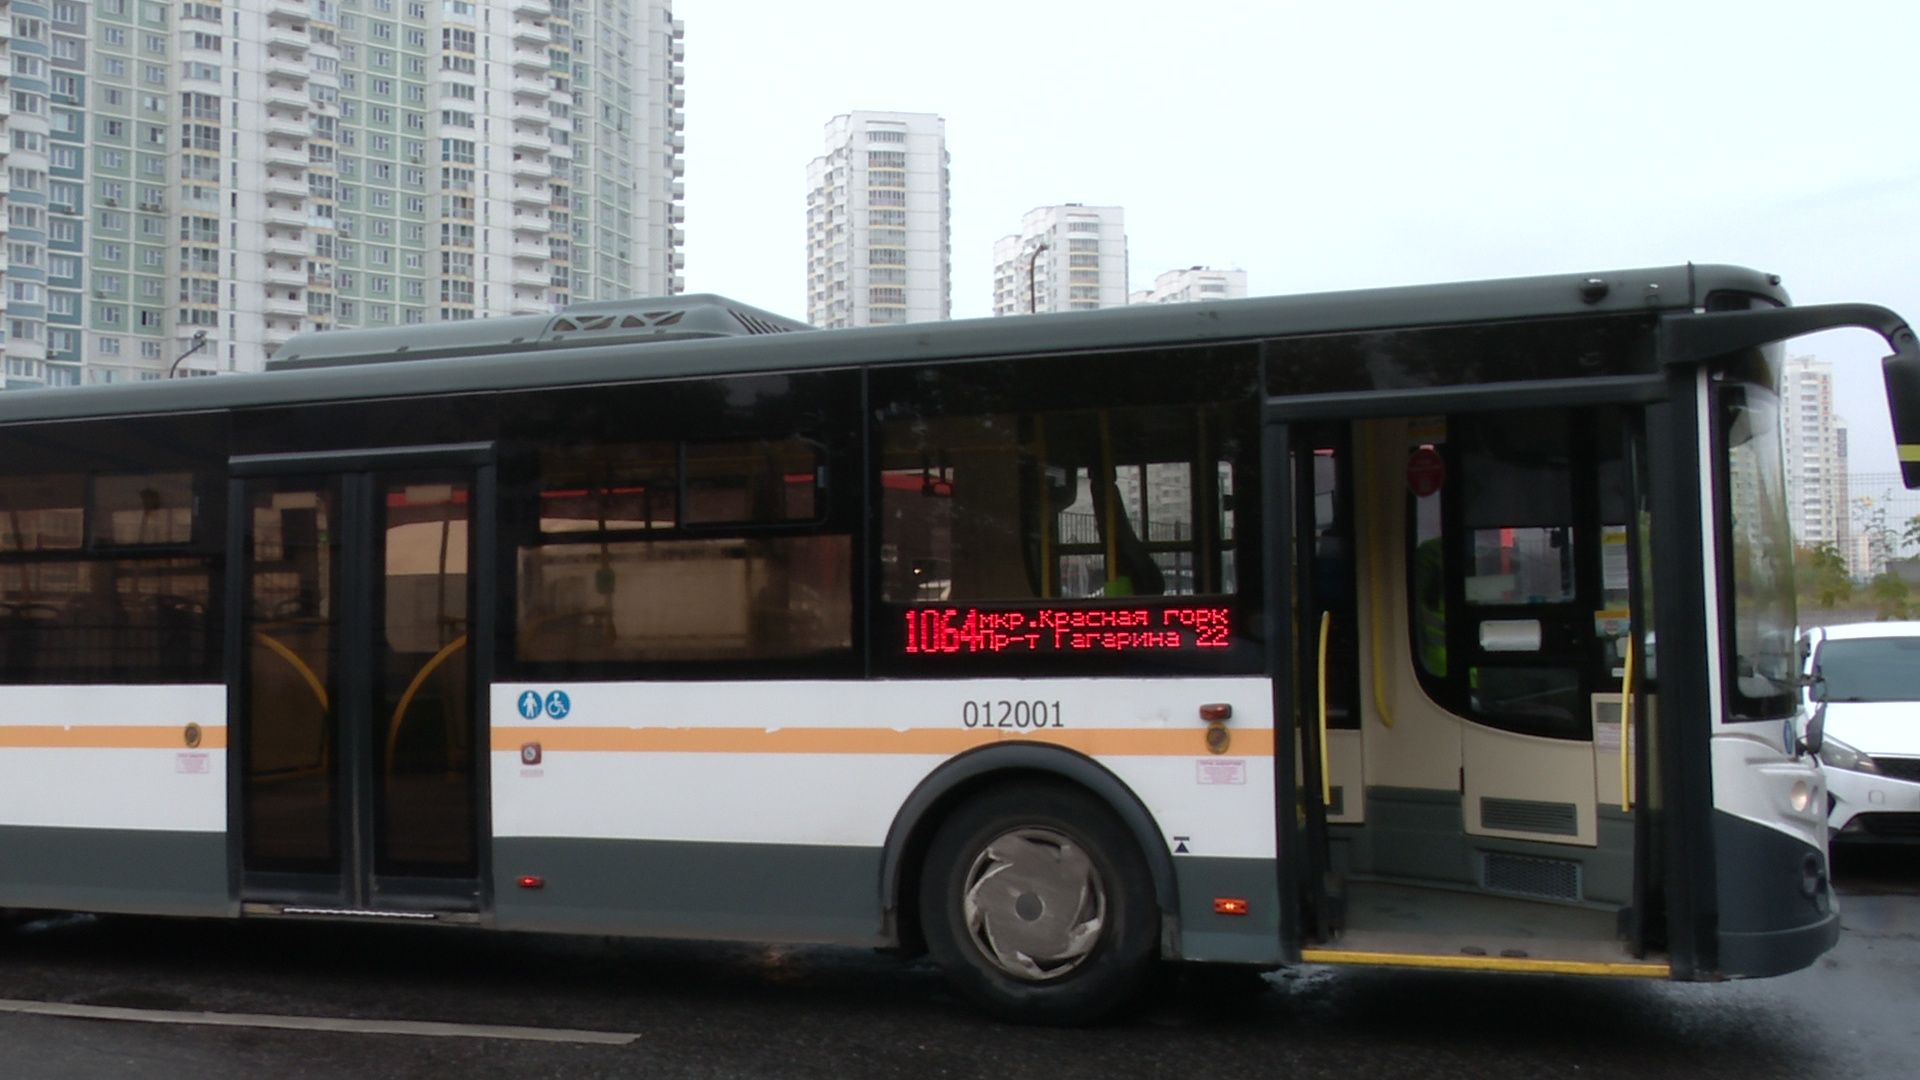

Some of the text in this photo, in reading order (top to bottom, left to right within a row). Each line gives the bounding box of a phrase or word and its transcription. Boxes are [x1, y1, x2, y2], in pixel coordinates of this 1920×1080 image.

[905, 609, 978, 652] 1064
[1055, 628, 1181, 650] Гагарина
[1196, 625, 1229, 647] 22
[963, 700, 1064, 728] 012001
